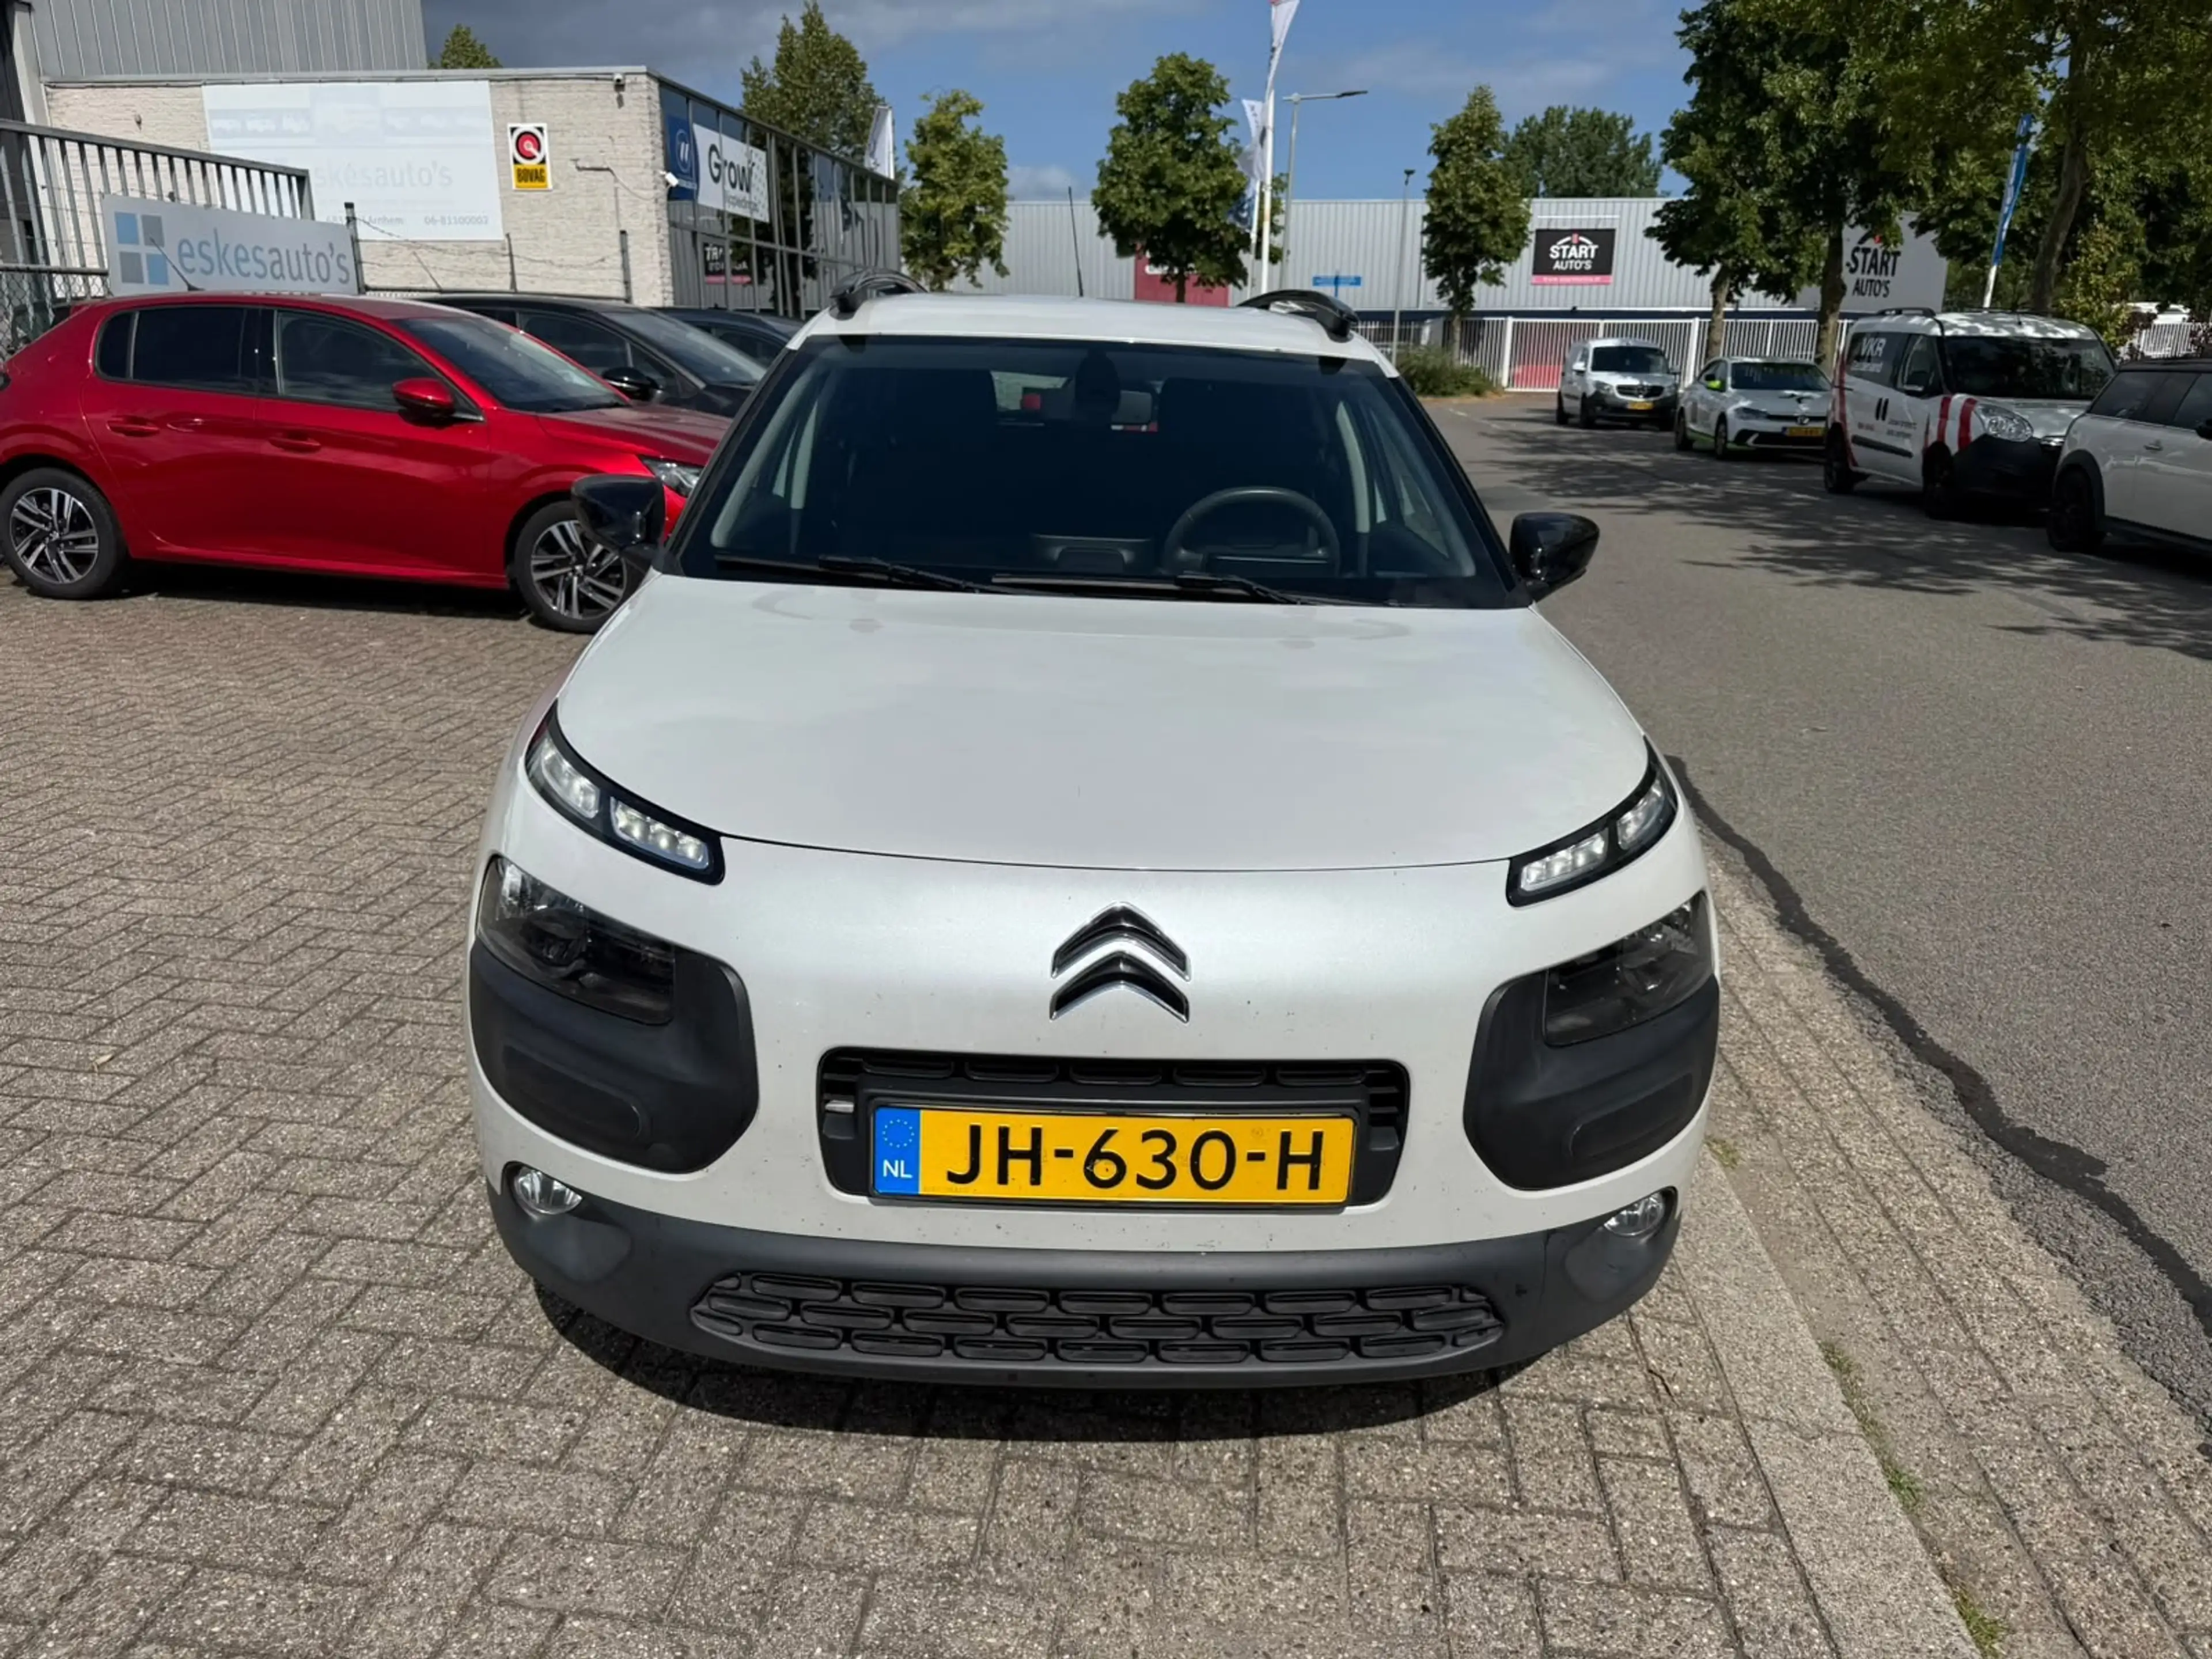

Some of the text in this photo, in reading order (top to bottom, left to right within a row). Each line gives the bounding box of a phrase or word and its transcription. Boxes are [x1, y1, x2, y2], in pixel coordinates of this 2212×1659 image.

[314, 157, 454, 189] skesauto's
[517, 167, 546, 183] BOVAG
[177, 227, 350, 285] eskesauto's
[1549, 244, 1599, 259] START
[1552, 259, 1593, 271] AUTO'S
[1846, 247, 1902, 277] START
[1852, 278, 1891, 298] AUTO'S
[1861, 337, 1887, 357] VKR
[947, 1124, 1324, 1190] JH-630-H
[882, 1160, 913, 1179] NL
